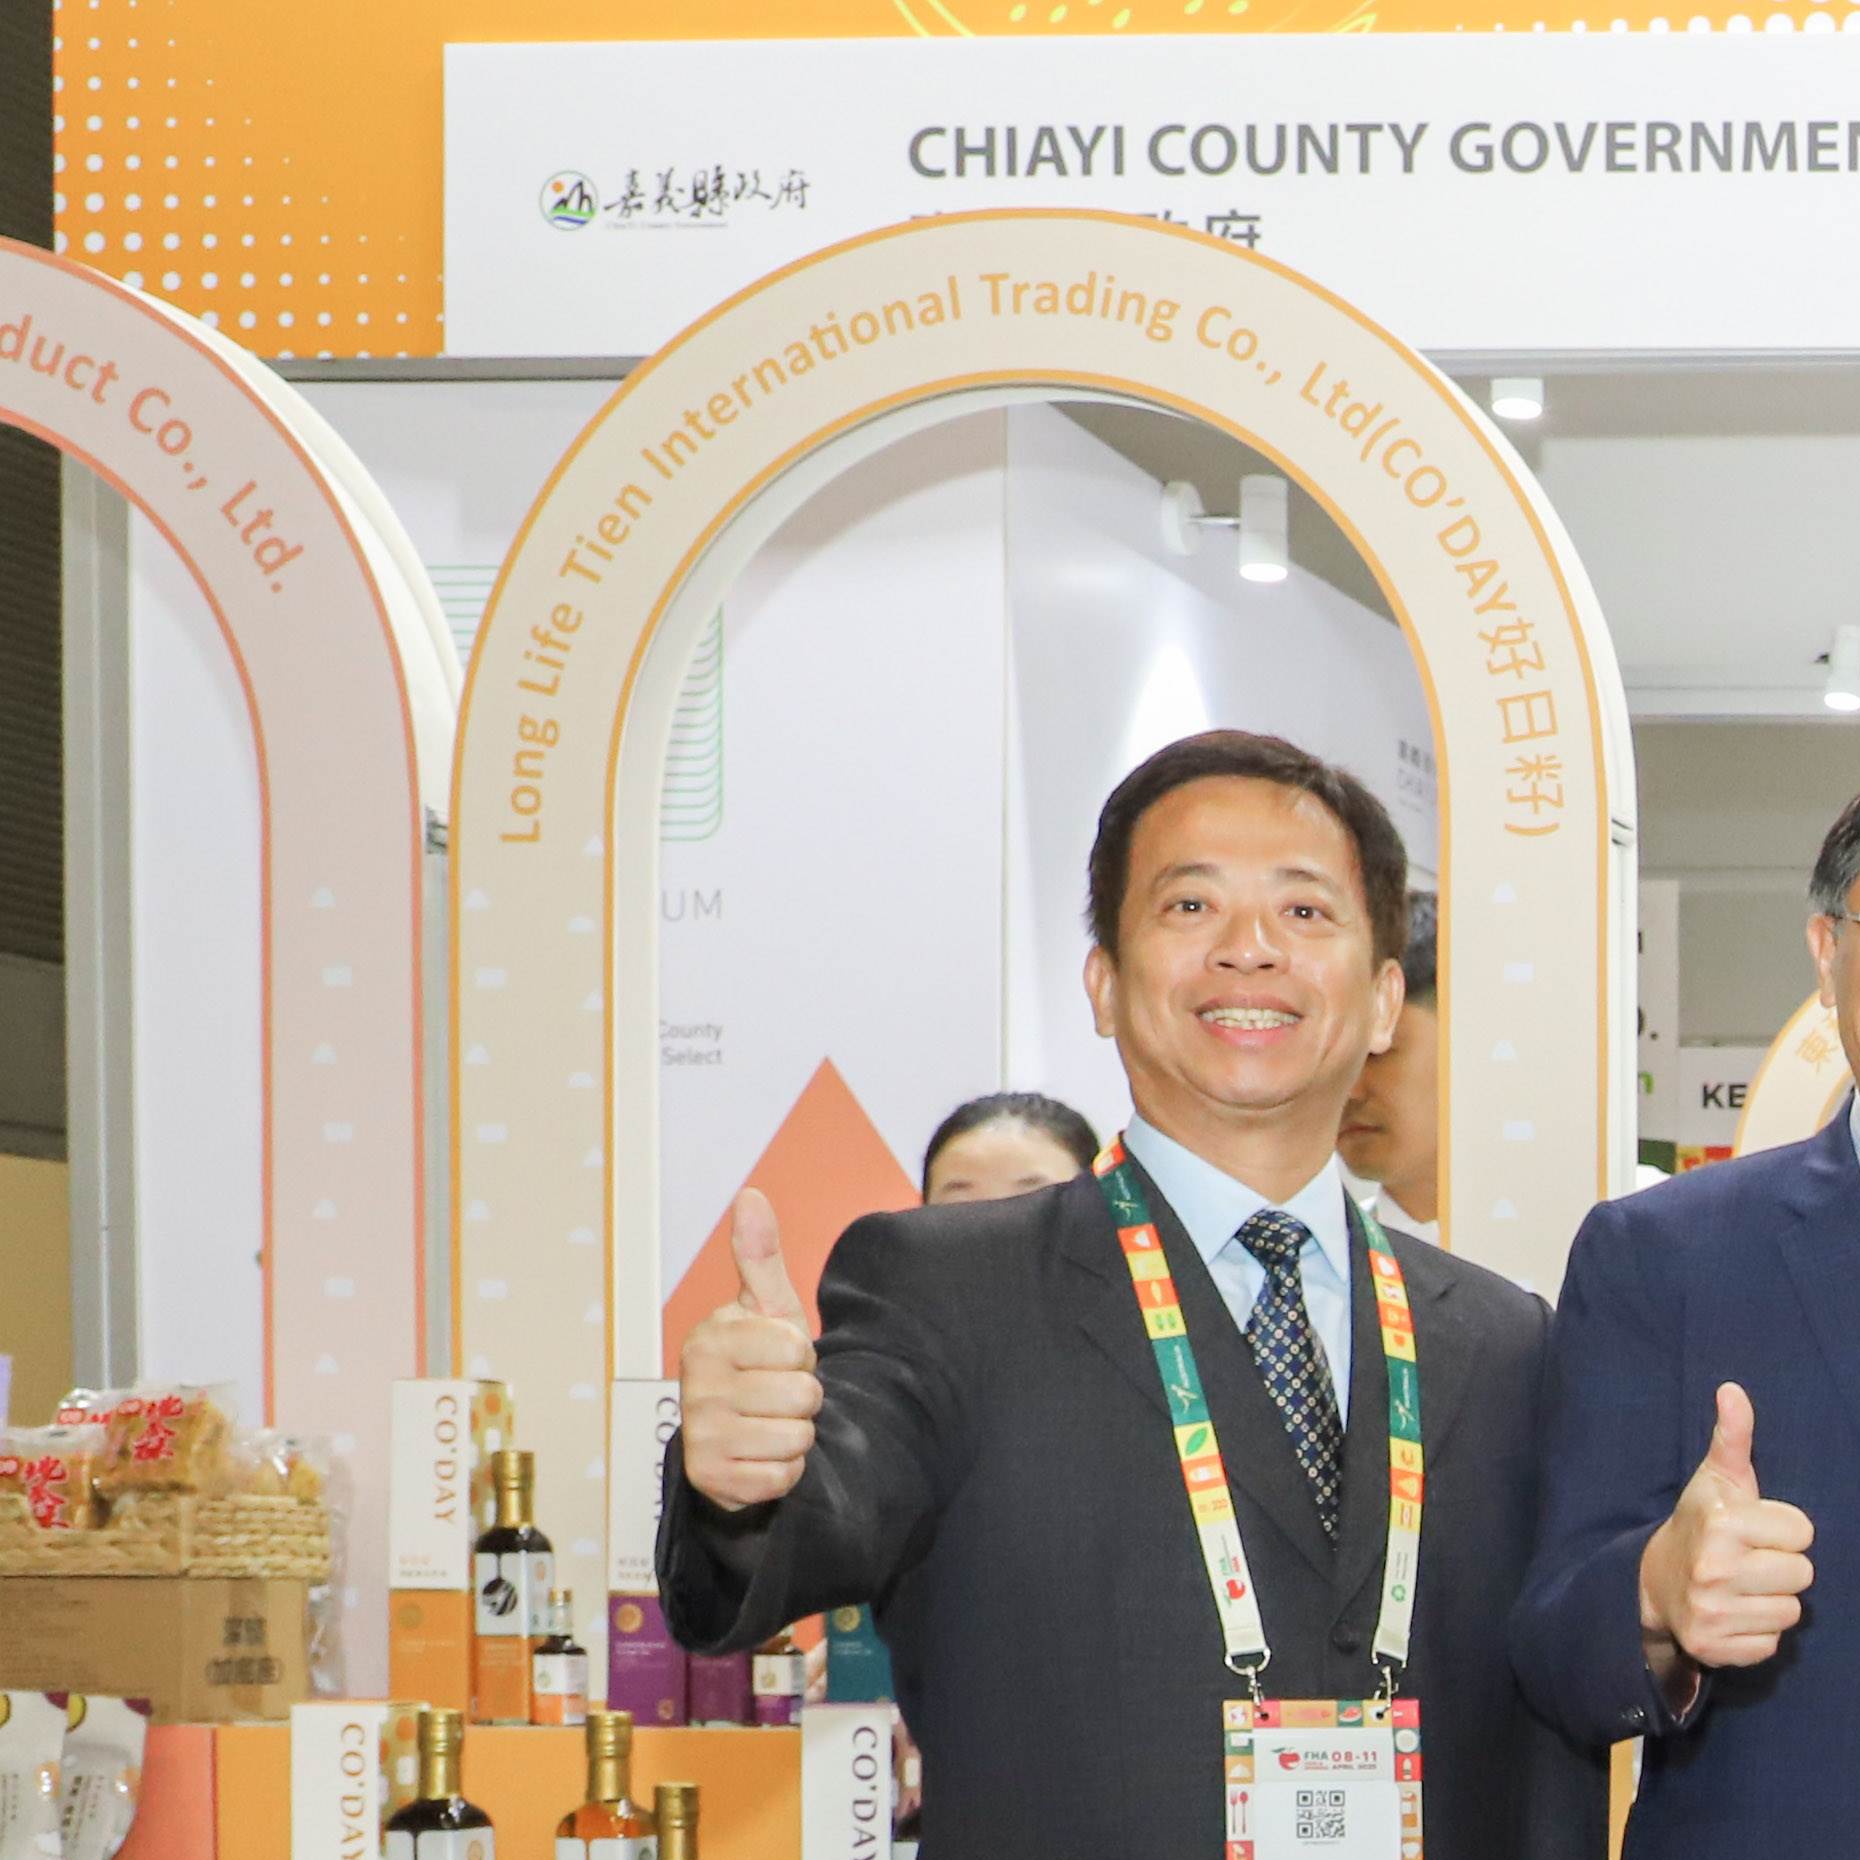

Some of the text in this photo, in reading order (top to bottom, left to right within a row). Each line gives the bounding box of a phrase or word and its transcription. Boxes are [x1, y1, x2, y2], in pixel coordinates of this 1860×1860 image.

[909, 125, 1124, 178] CHIAYI
[1149, 123, 1429, 176] COUNTY
[980, 271, 1182, 344] Trading
[1196, 305, 1284, 387] Co.,
[640, 274, 964, 481] International
[128, 386, 207, 490] Co.,
[221, 480, 304, 593] Ltd.
[560, 483, 654, 588] Tien
[517, 601, 584, 698] Life
[502, 716, 560, 844] Long
[433, 1394, 459, 1526] CO'DAY
